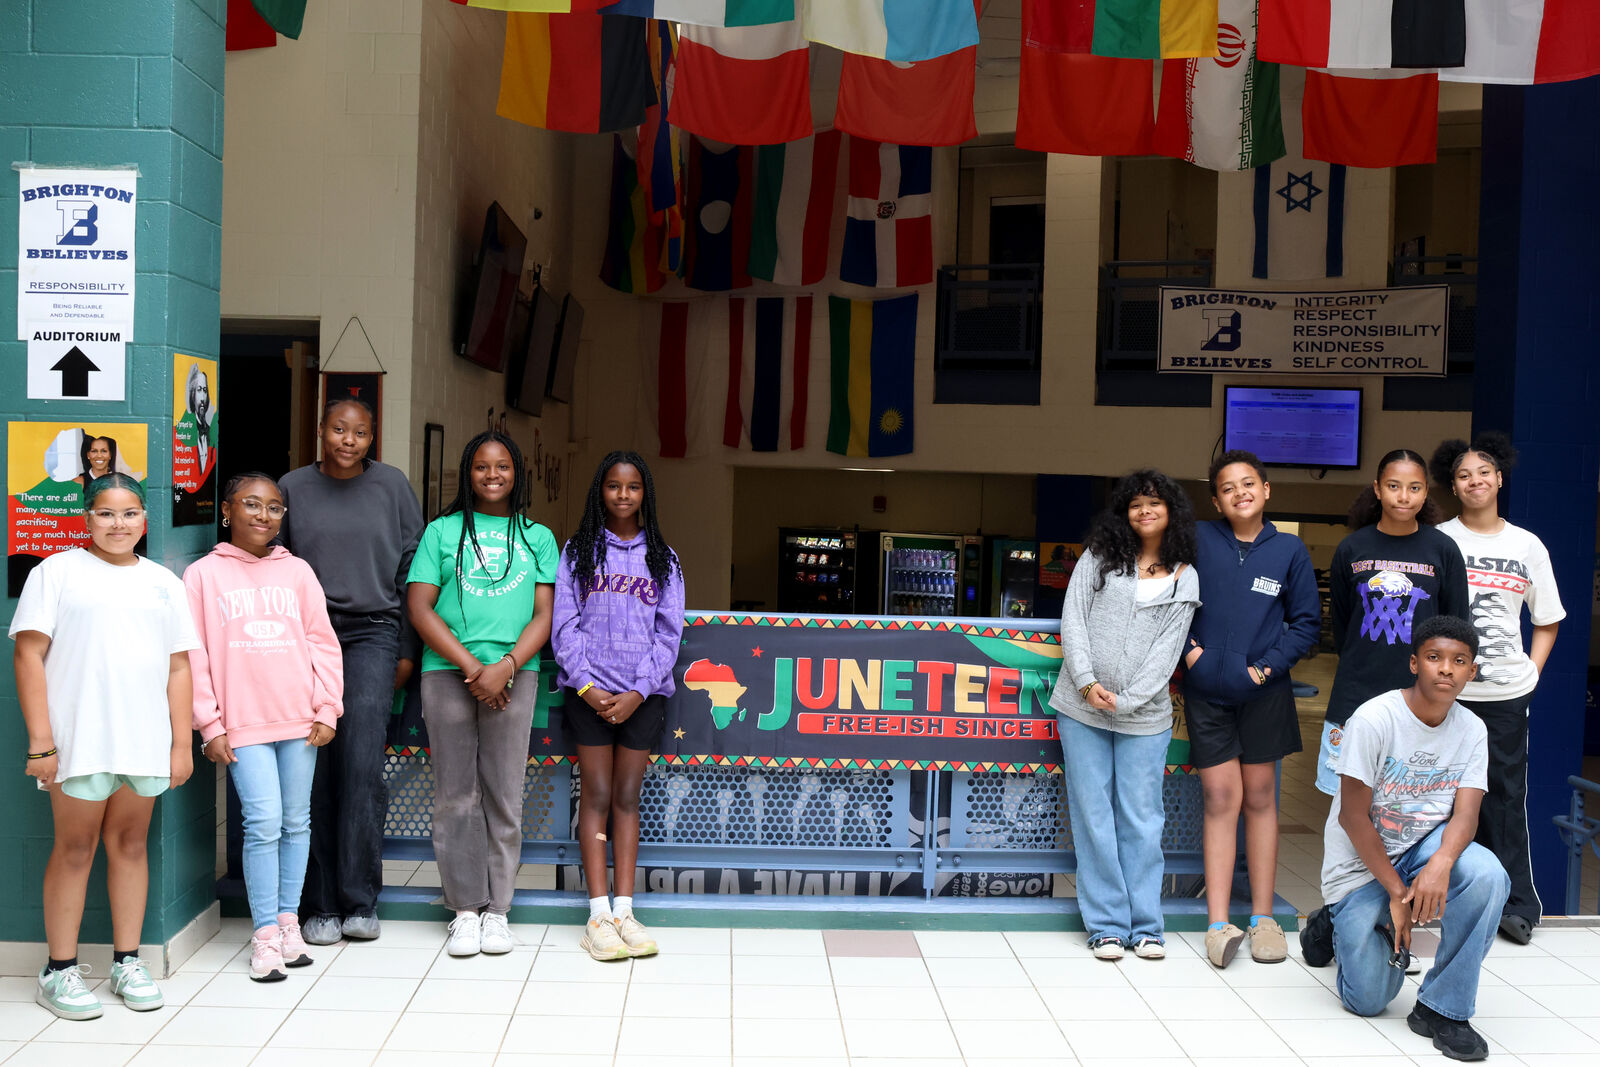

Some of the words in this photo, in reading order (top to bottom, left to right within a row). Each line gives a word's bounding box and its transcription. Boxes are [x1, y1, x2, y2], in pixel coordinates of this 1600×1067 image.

[22, 184, 134, 203] BRIGHTON
[26, 249, 129, 260] BELIEVES
[29, 281, 126, 291] RESPONSIBILITY
[1170, 293, 1278, 311] BRIGHTON
[1294, 294, 1390, 308] INTEGRITY
[1293, 309, 1377, 321] RESPECT
[33, 331, 121, 342] AUDITORIUM
[1293, 325, 1442, 337] RESPONSIBILITY
[1293, 341, 1385, 353] KINDNESS
[1170, 356, 1273, 369] BELIEVES
[1293, 356, 1337, 369] SELF
[1341, 357, 1429, 369] CONTROL
[46, 494, 60, 502] are
[63, 492, 78, 502] still
[16, 507, 38, 515] many
[16, 518, 57, 528] sacrificing
[44, 530, 66, 539] much
[68, 530, 92, 539] histor
[16, 543, 29, 552] yet
[31, 542, 40, 551] to
[42, 542, 53, 551] be
[1351, 560, 1374, 574] EAST
[1374, 560, 1435, 577] BASKETBALL
[487, 570, 529, 597] SCHOOL
[1253, 577, 1282, 594] BRUINS
[1466, 573, 1526, 593] ORTS
[216, 588, 256, 627] NEW
[252, 624, 277, 636] USA
[756, 656, 1058, 731] JUNETEEN
[822, 715, 944, 736] FREE-ISH
[955, 719, 1034, 738] SINCE
[1409, 750, 1441, 767] Ford
